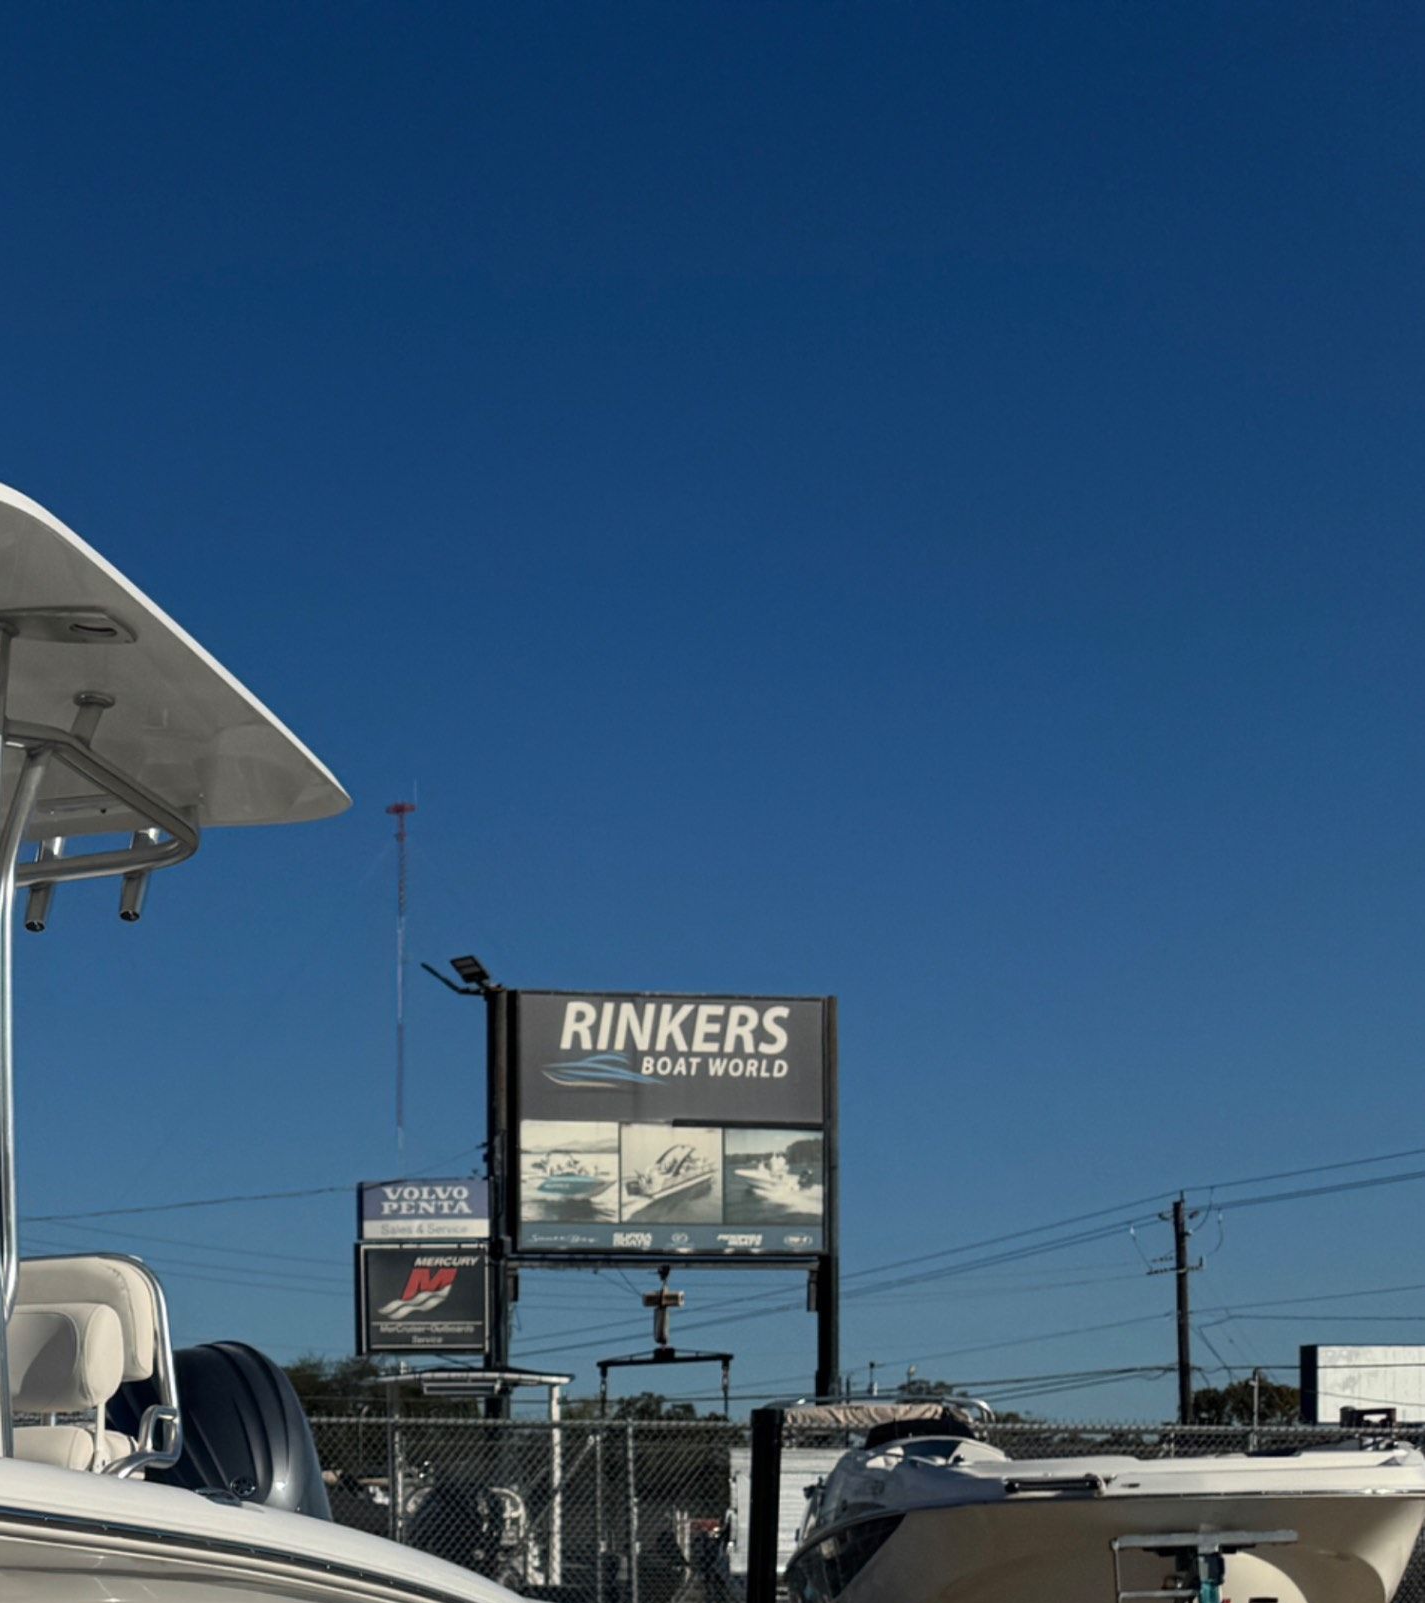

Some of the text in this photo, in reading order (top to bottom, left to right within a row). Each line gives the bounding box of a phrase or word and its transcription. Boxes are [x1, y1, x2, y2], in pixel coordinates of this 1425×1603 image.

[559, 1001, 790, 1055] RINKERS
[641, 1056, 789, 1078] BOAT WORLD
[381, 1186, 470, 1200] VOLVO
[381, 1201, 472, 1215] PENTA
[414, 1256, 479, 1267] MERCURY
